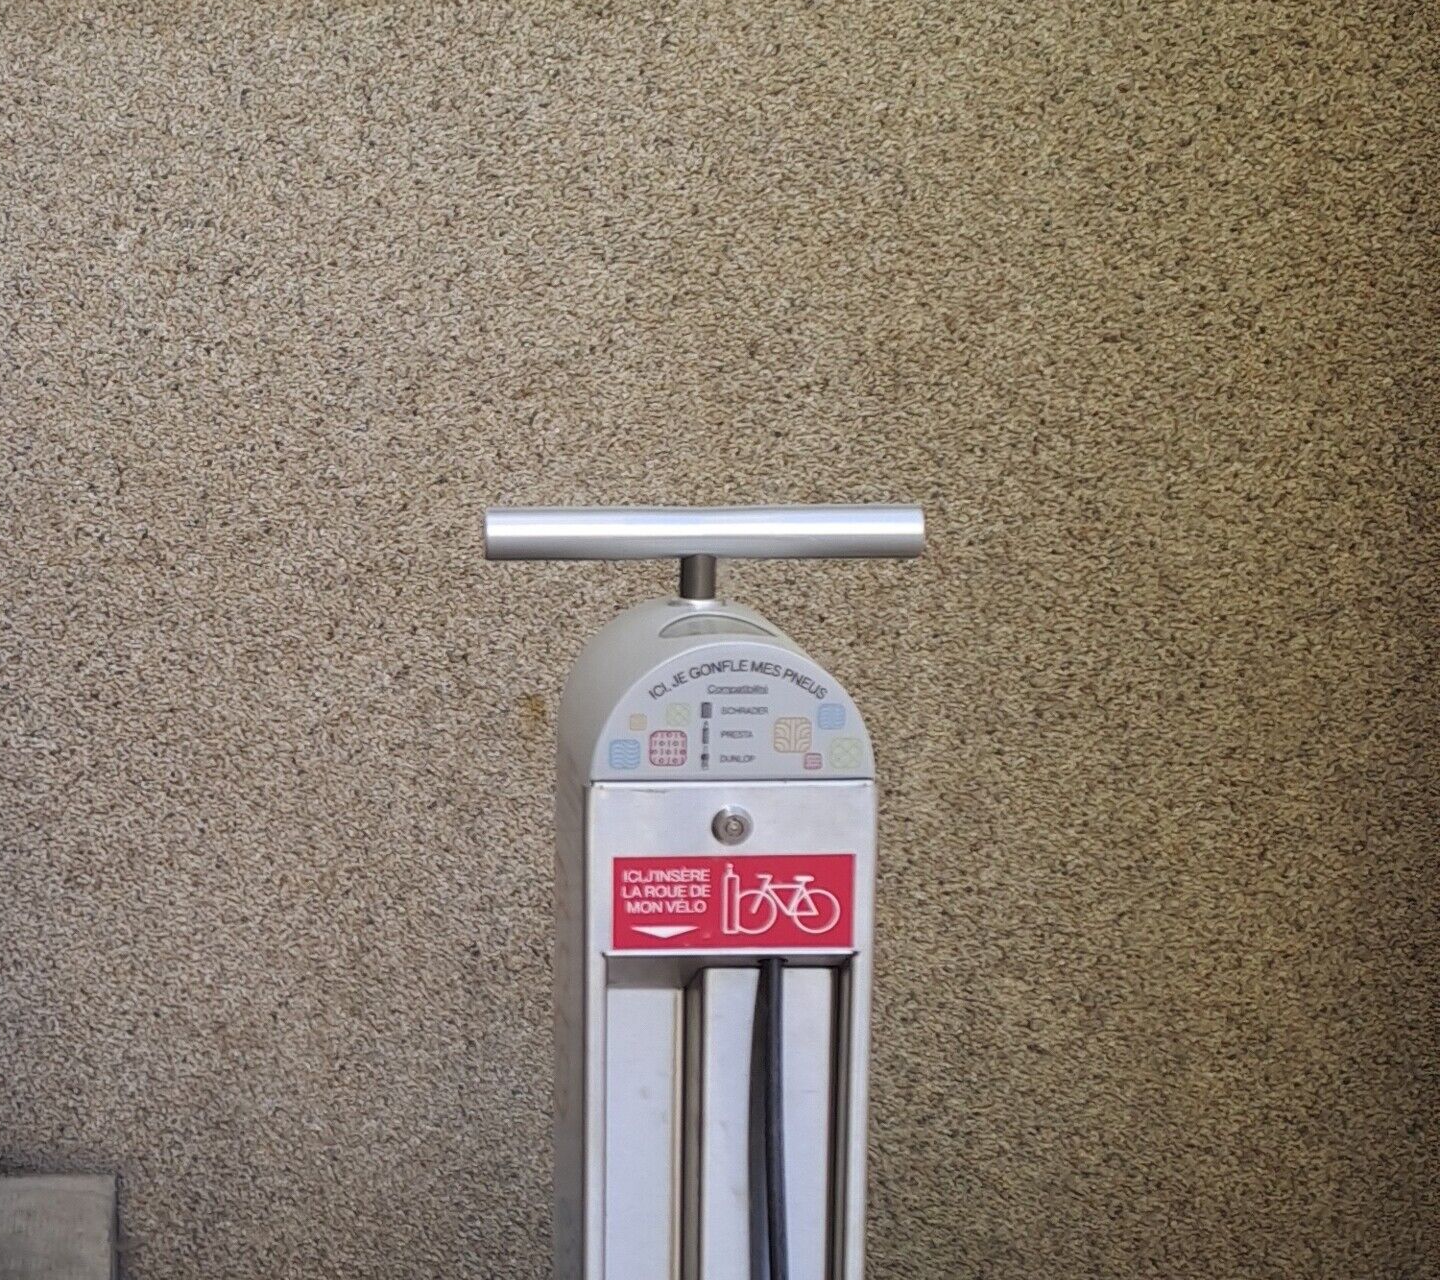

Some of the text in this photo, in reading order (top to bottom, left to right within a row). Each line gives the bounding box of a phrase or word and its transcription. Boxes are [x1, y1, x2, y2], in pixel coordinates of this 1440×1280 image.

[672, 671, 688, 688] JE
[689, 659, 749, 679] GONFLE
[750, 660, 782, 677] MES
[781, 668, 828, 700] PNEUS
[720, 730, 753, 739] PRESTA
[719, 754, 756, 763] DUNLOP
[622, 884, 711, 898] LA ROUE DE
[626, 899, 707, 914] MON VÉLO
